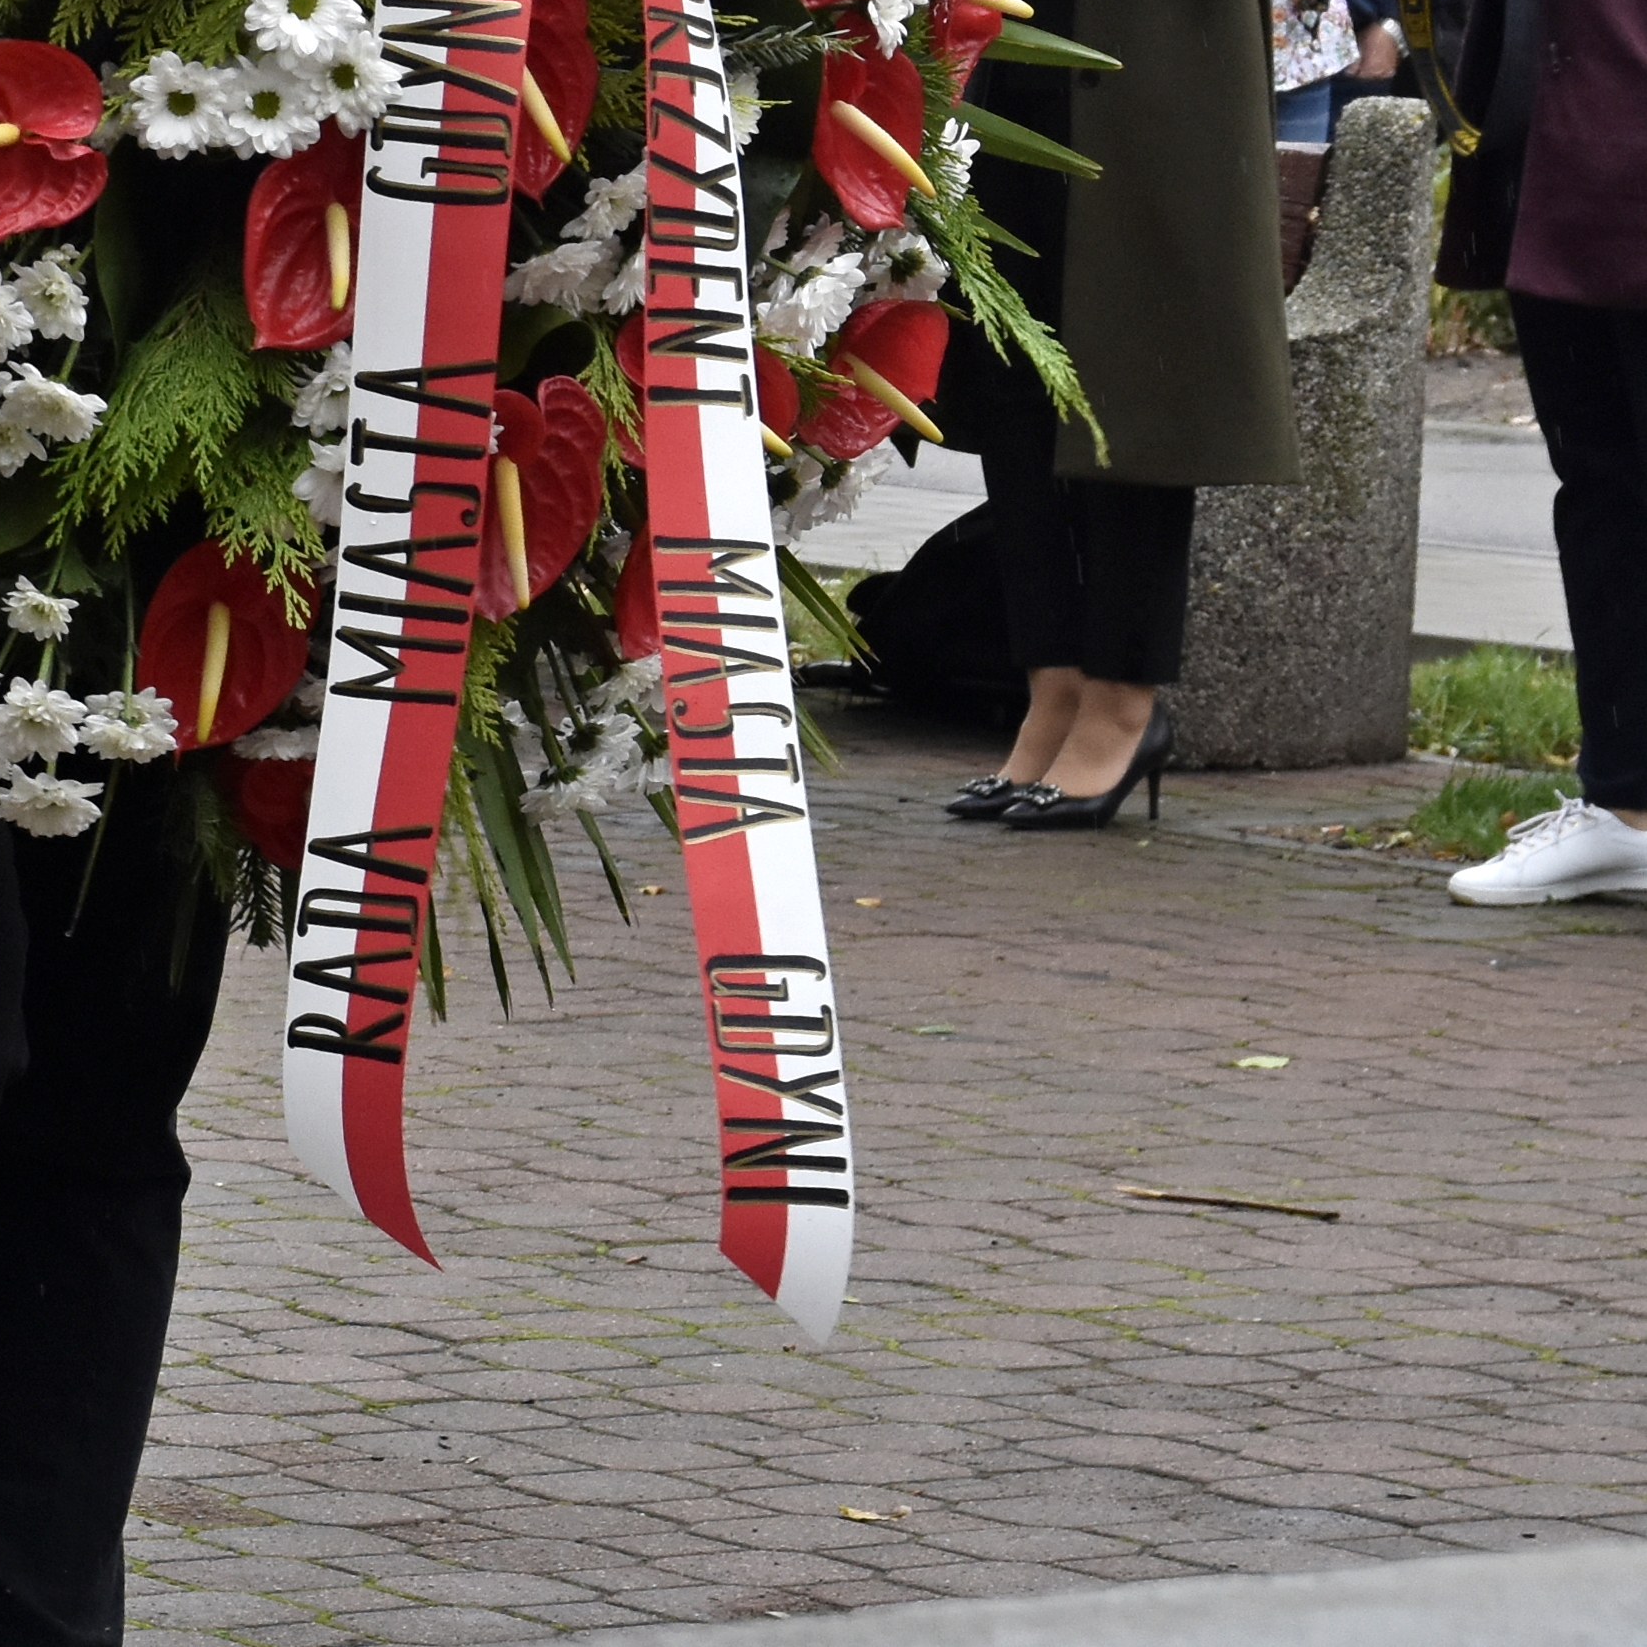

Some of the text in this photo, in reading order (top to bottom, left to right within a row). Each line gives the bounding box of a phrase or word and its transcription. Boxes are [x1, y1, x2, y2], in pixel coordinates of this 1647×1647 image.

[329, 358, 498, 706] MIASTA
[653, 536, 805, 845] MIASTA
[287, 823, 434, 1064] RADA
[705, 954, 850, 1209] GDYNI
